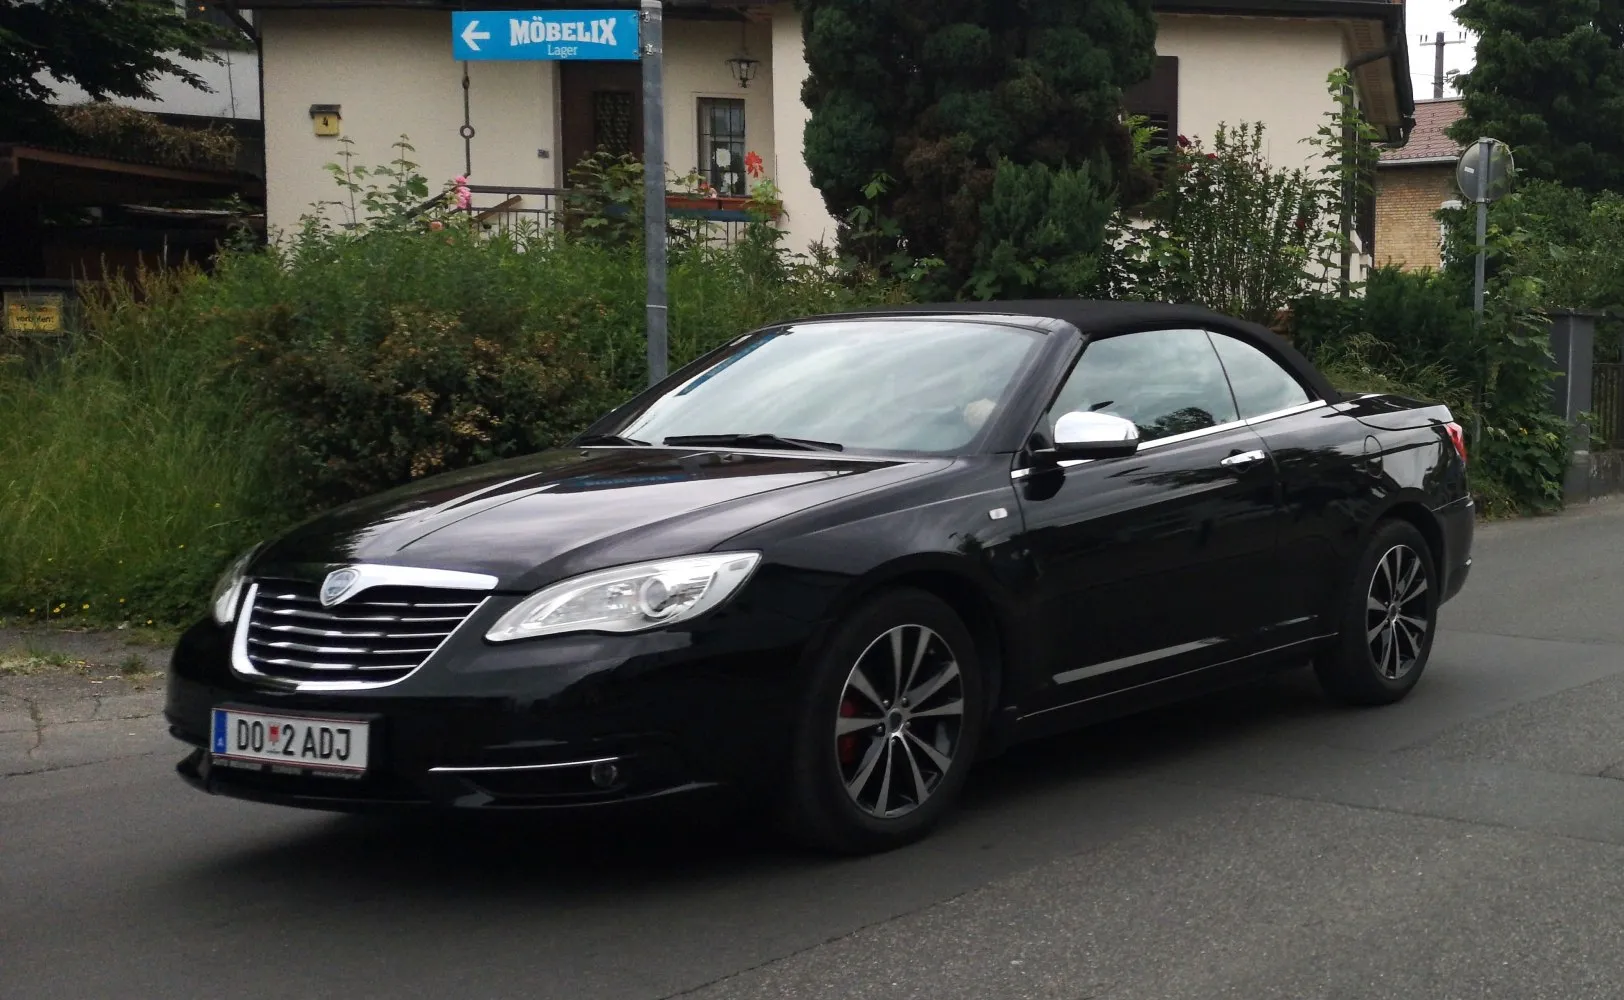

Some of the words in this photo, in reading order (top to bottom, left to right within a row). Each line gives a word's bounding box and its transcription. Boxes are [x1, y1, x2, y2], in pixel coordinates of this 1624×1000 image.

[509, 16, 617, 46] MÖBELIX
[547, 45, 578, 58] Lager
[322, 116, 329, 127] 4
[237, 719, 264, 752] DO
[282, 723, 296, 756] 2
[301, 726, 352, 761] ADJ
